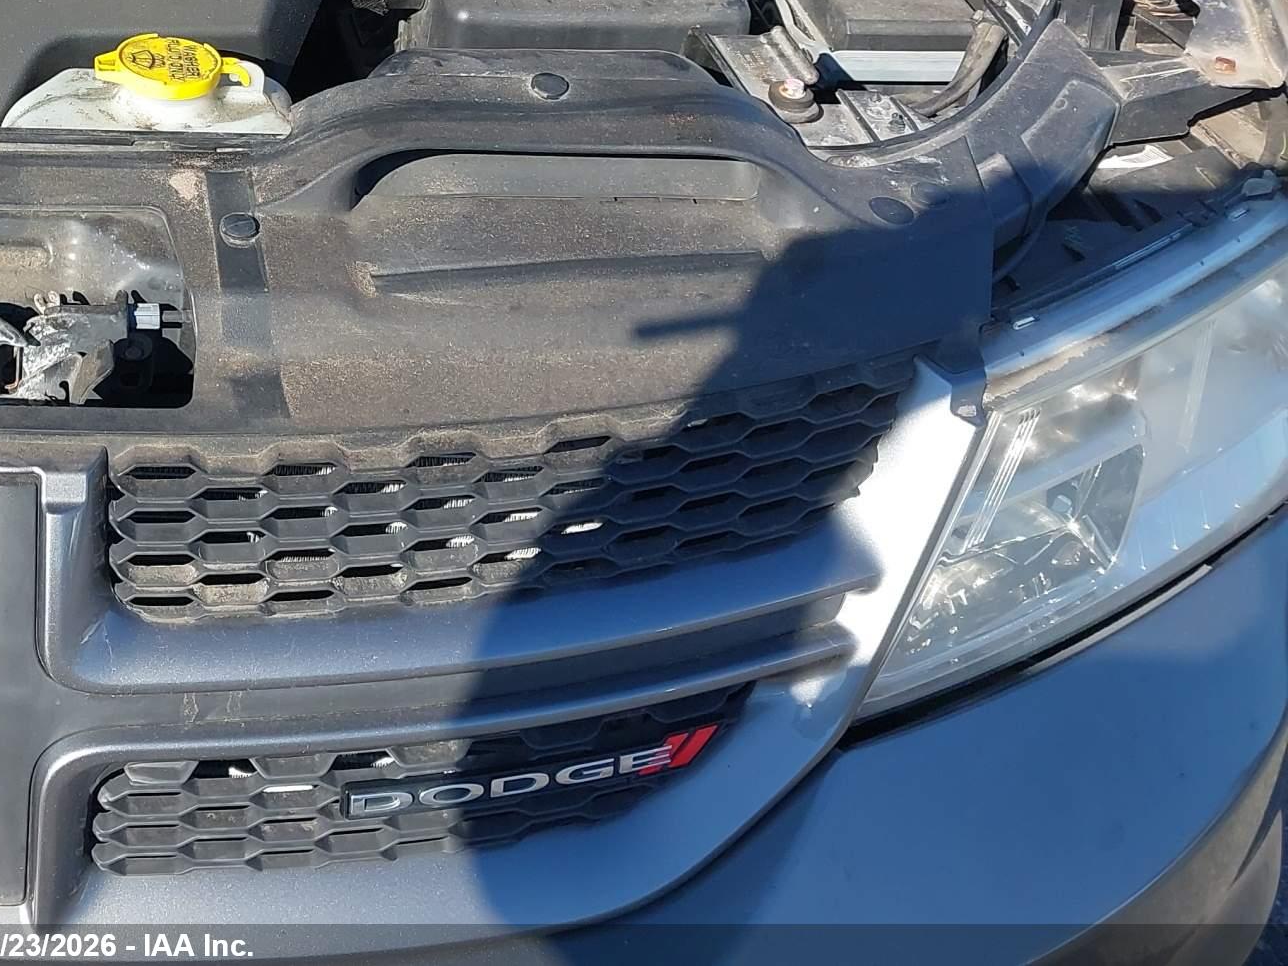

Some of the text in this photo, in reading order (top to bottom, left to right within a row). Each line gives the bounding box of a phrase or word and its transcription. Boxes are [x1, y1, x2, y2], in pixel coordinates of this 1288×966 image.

[166, 39, 185, 82] FLUID ONLY
[183, 44, 201, 80] WASHER
[349, 744, 673, 816] DODGE
